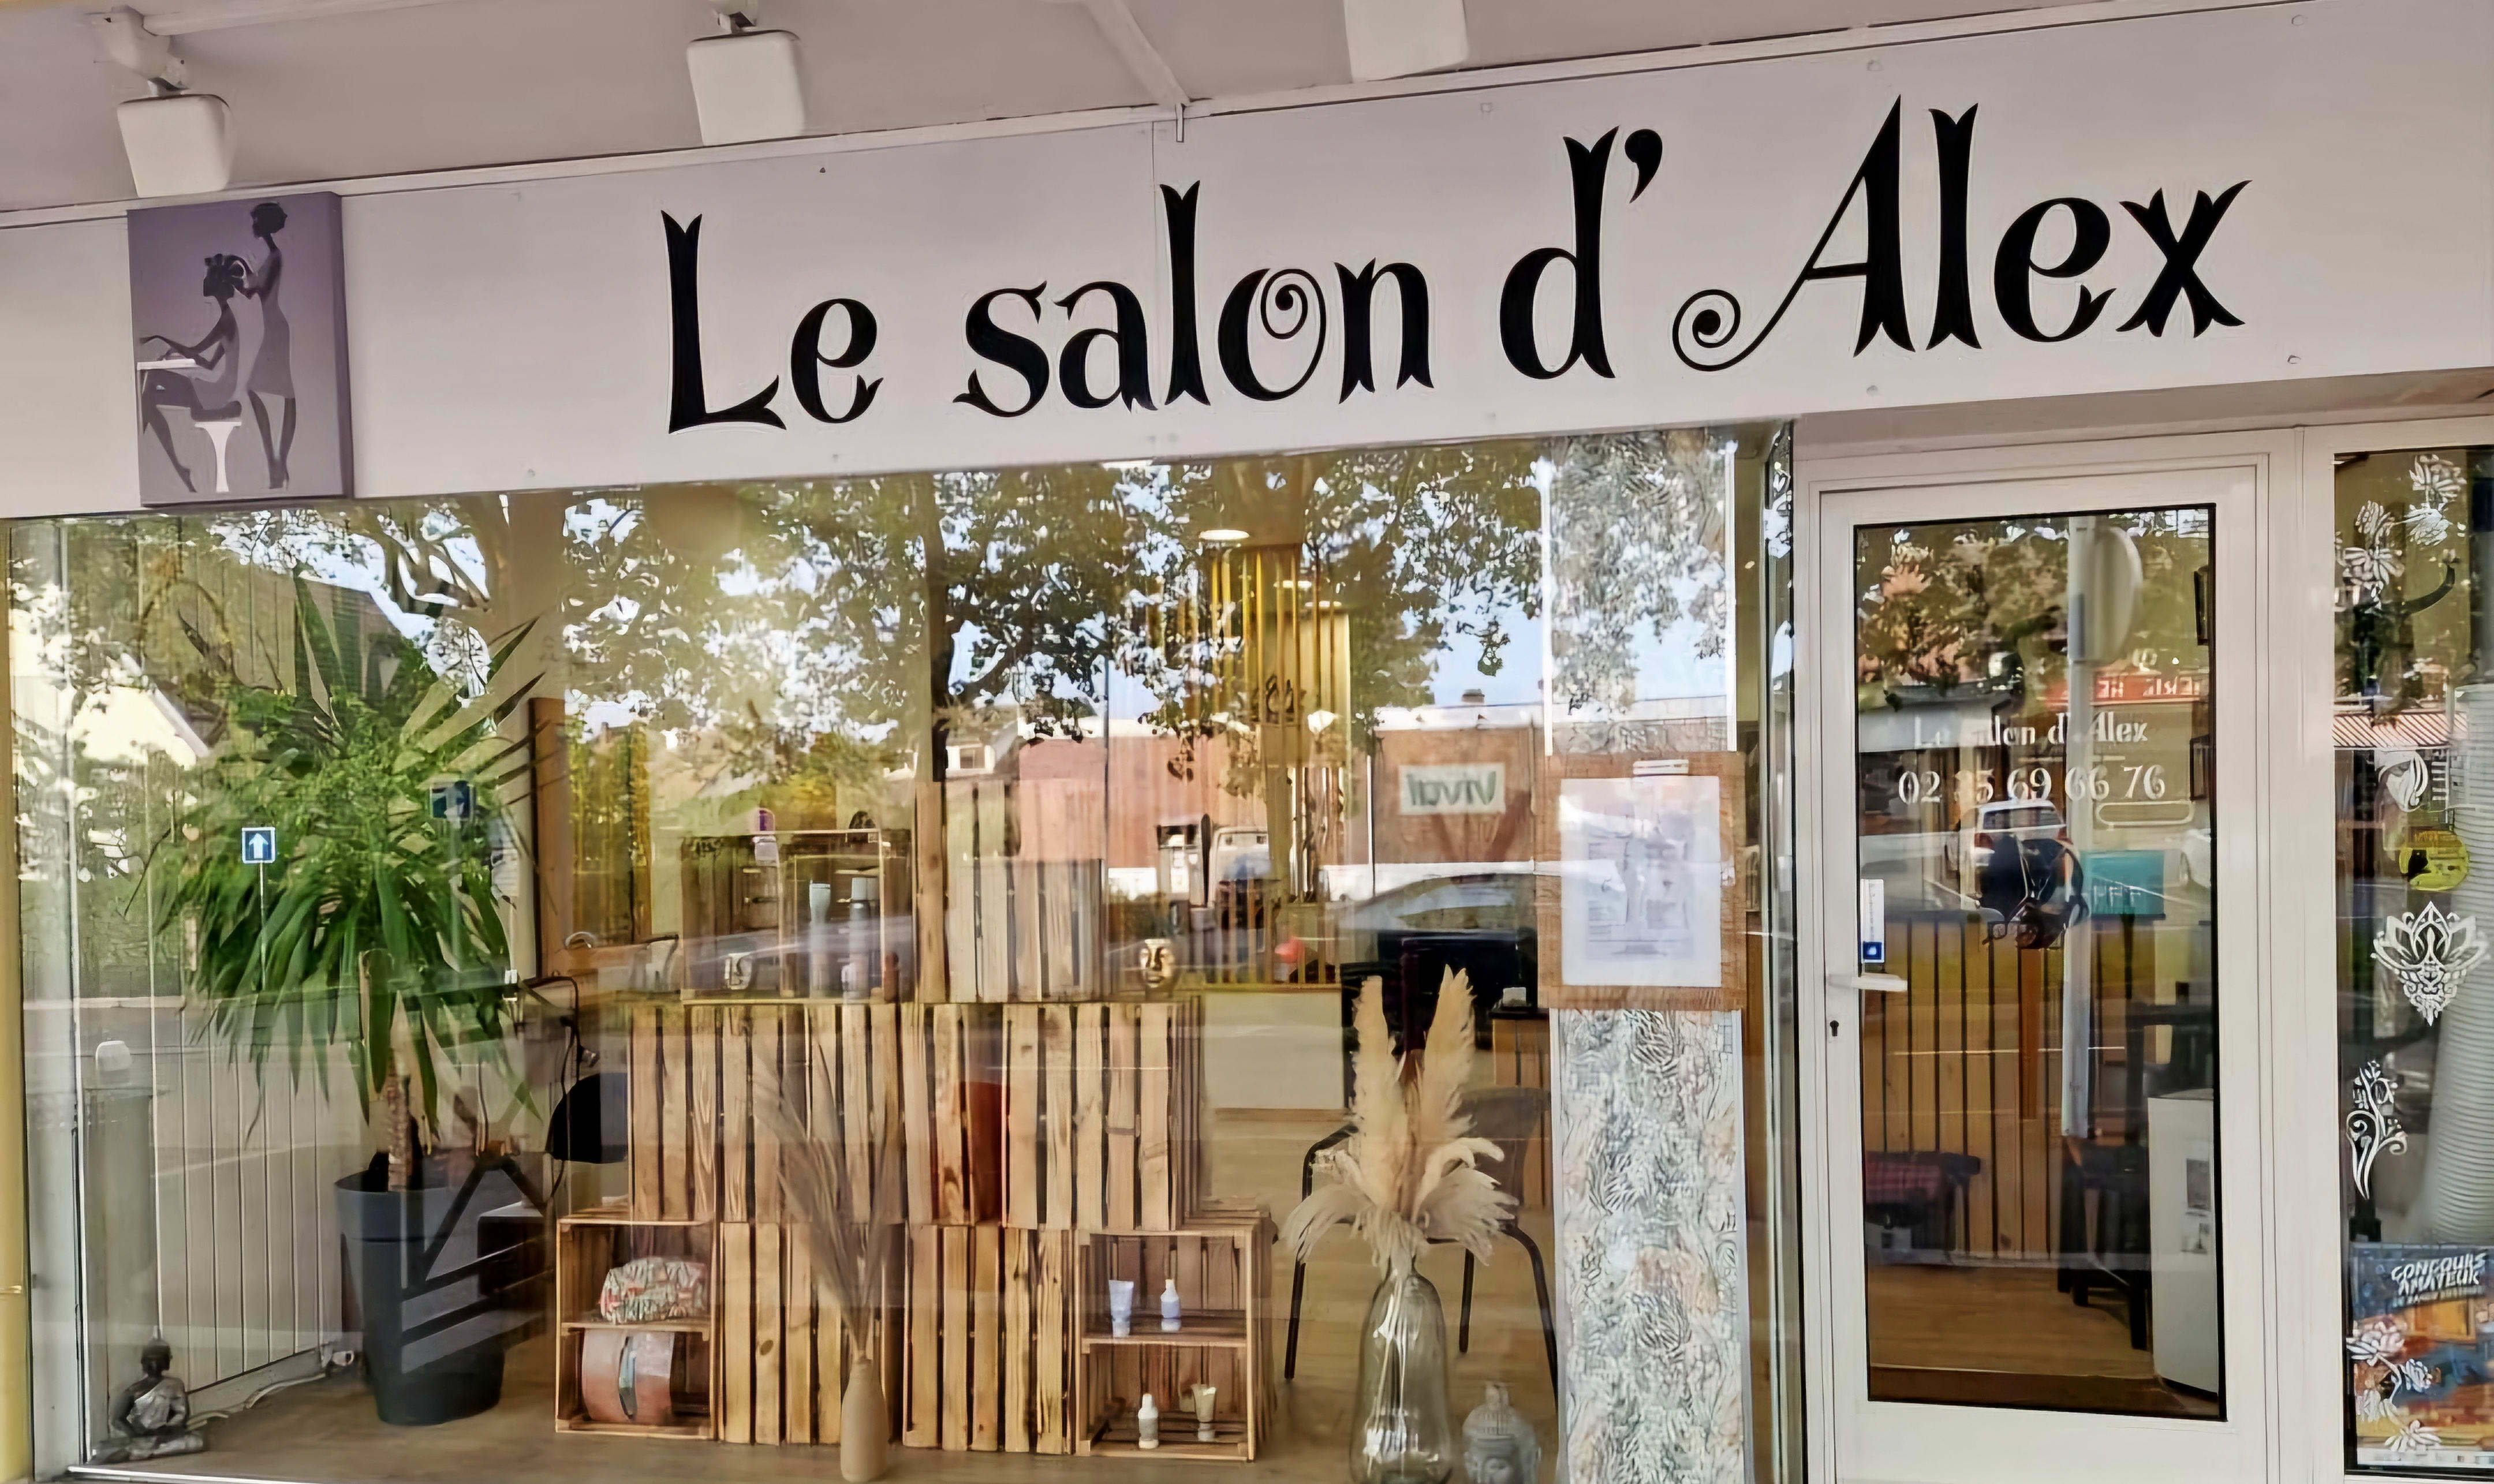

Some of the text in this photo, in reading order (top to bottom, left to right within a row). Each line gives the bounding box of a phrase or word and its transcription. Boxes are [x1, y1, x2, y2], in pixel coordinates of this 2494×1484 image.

[661, 95, 2251, 433] Le salon d' Alex
[2082, 711, 2148, 743] Alex
[1899, 770, 1942, 805] 02
[2007, 767, 2052, 802] 69
[2064, 765, 2110, 802] 66
[2120, 764, 2166, 801] 76
[2391, 1253, 2487, 1281] CONCOURS
